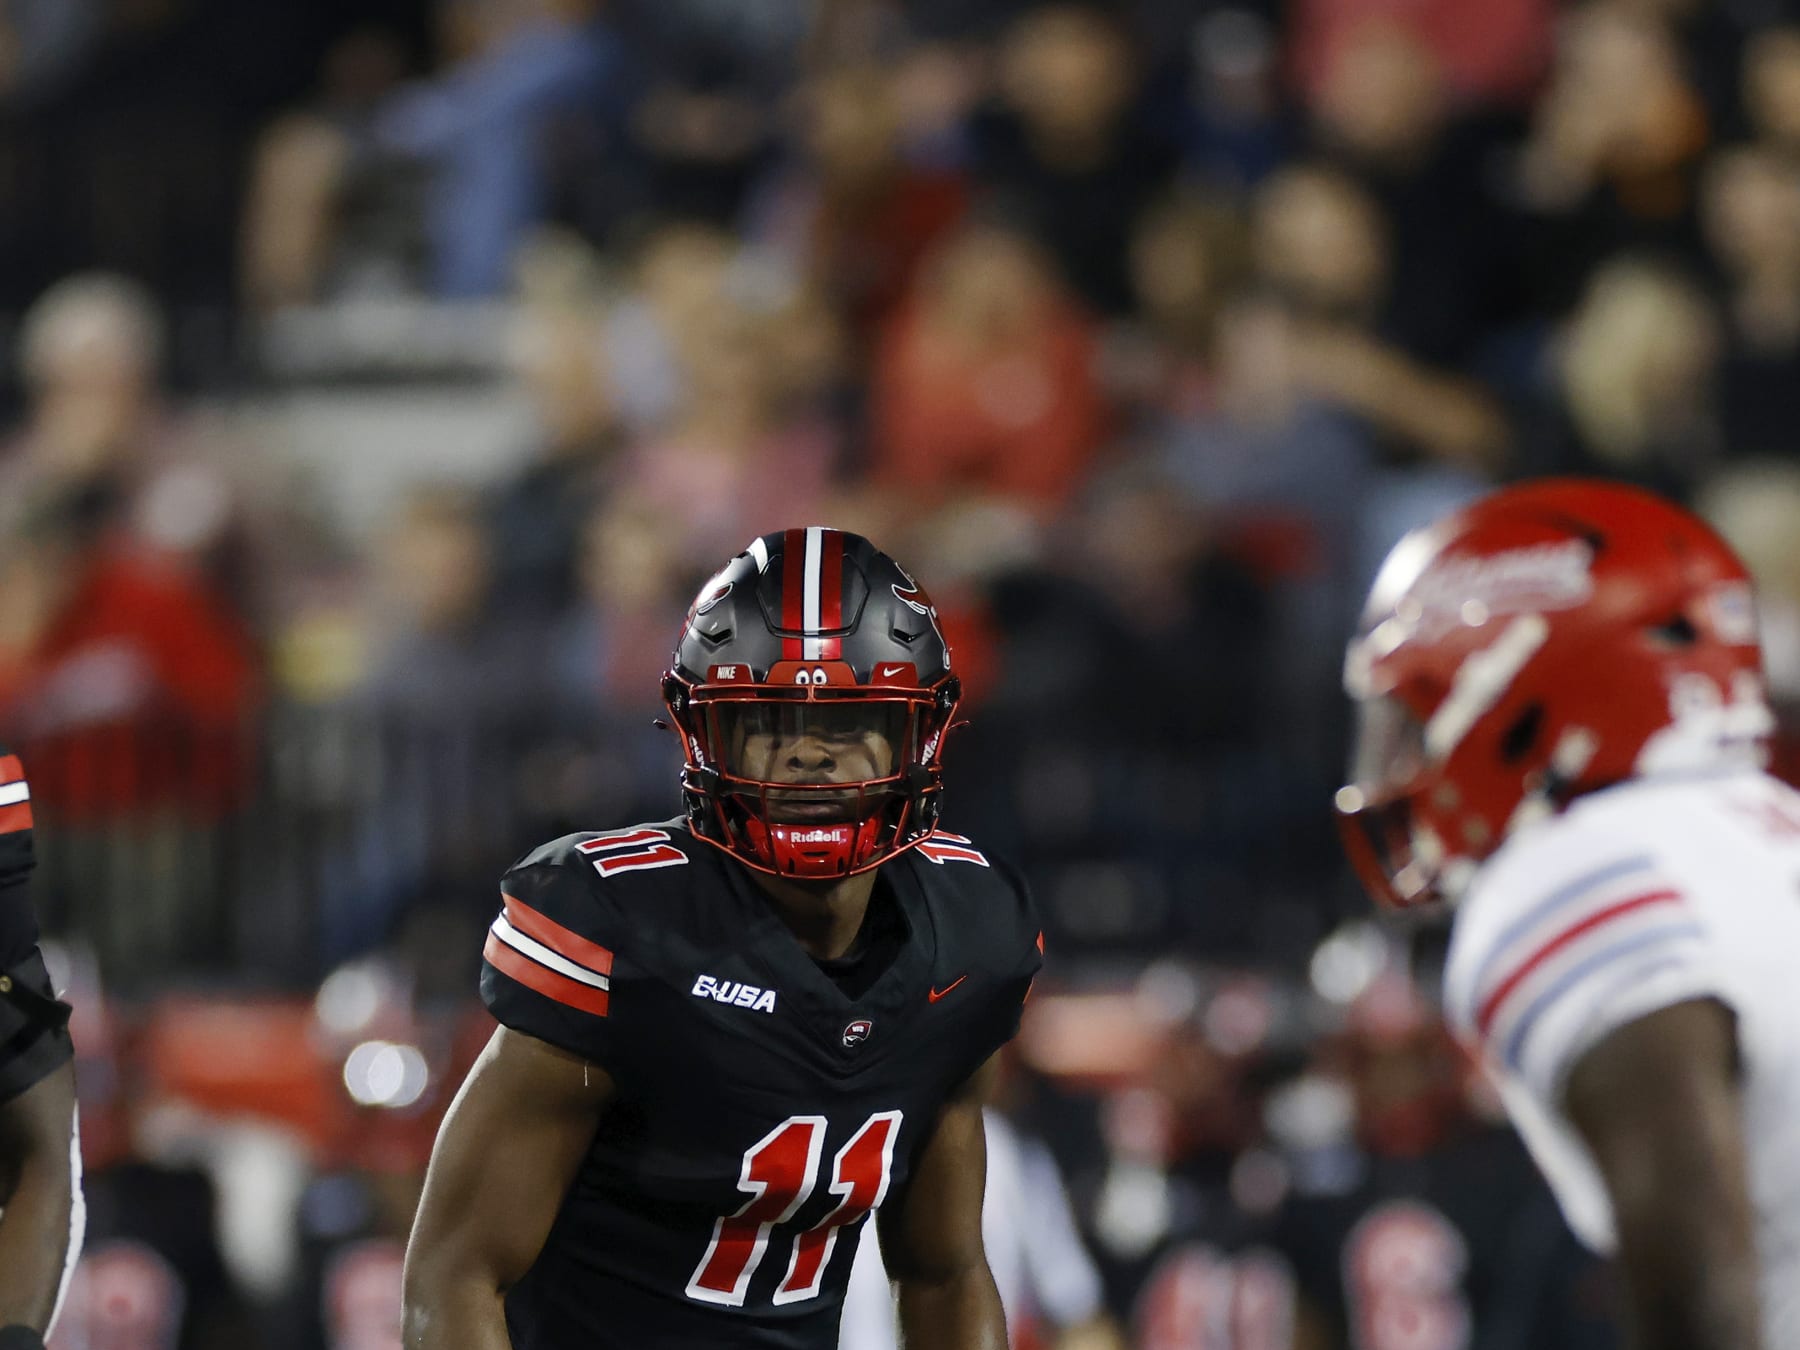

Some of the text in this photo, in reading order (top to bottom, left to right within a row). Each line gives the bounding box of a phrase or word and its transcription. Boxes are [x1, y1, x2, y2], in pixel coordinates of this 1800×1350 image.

[716, 666, 736, 680] NIKE
[790, 830, 841, 843] Riddell
[574, 829, 689, 878] 11
[684, 1109, 904, 1307] 11
